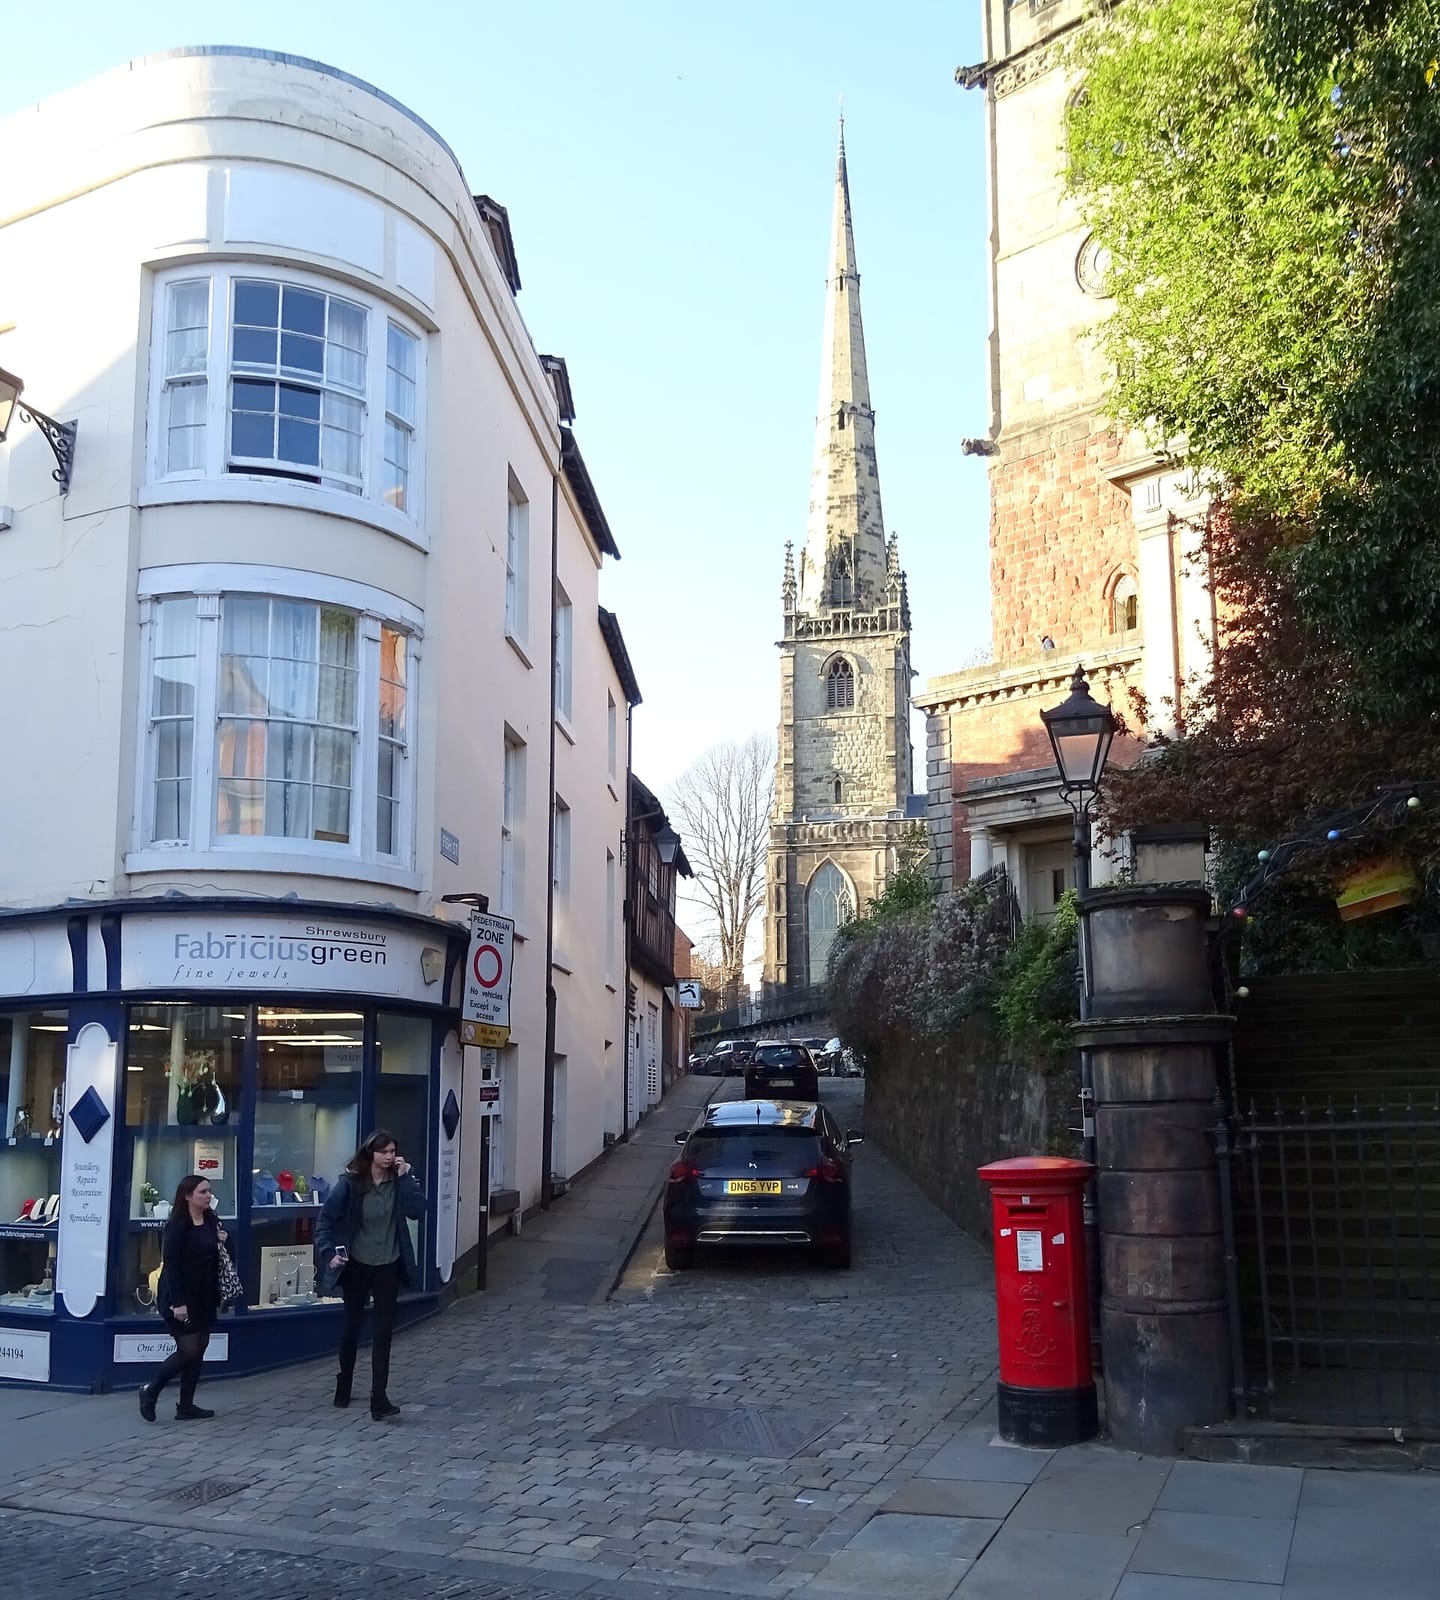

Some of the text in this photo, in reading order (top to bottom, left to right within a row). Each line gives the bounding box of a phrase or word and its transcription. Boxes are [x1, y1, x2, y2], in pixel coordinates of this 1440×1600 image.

[473, 915, 510, 931] PEDESTRIAN
[305, 925, 387, 943] Shrewsbury
[477, 927, 505, 945] ZONE
[172, 964, 289, 982] fine jewels
[470, 986, 503, 1001] No vehicles
[470, 999, 502, 1013] Except for
[476, 1012, 495, 1021] access
[730, 1182, 757, 1192] DN65
[760, 1182, 779, 1192] YVP
[136, 1343, 155, 1353] One
